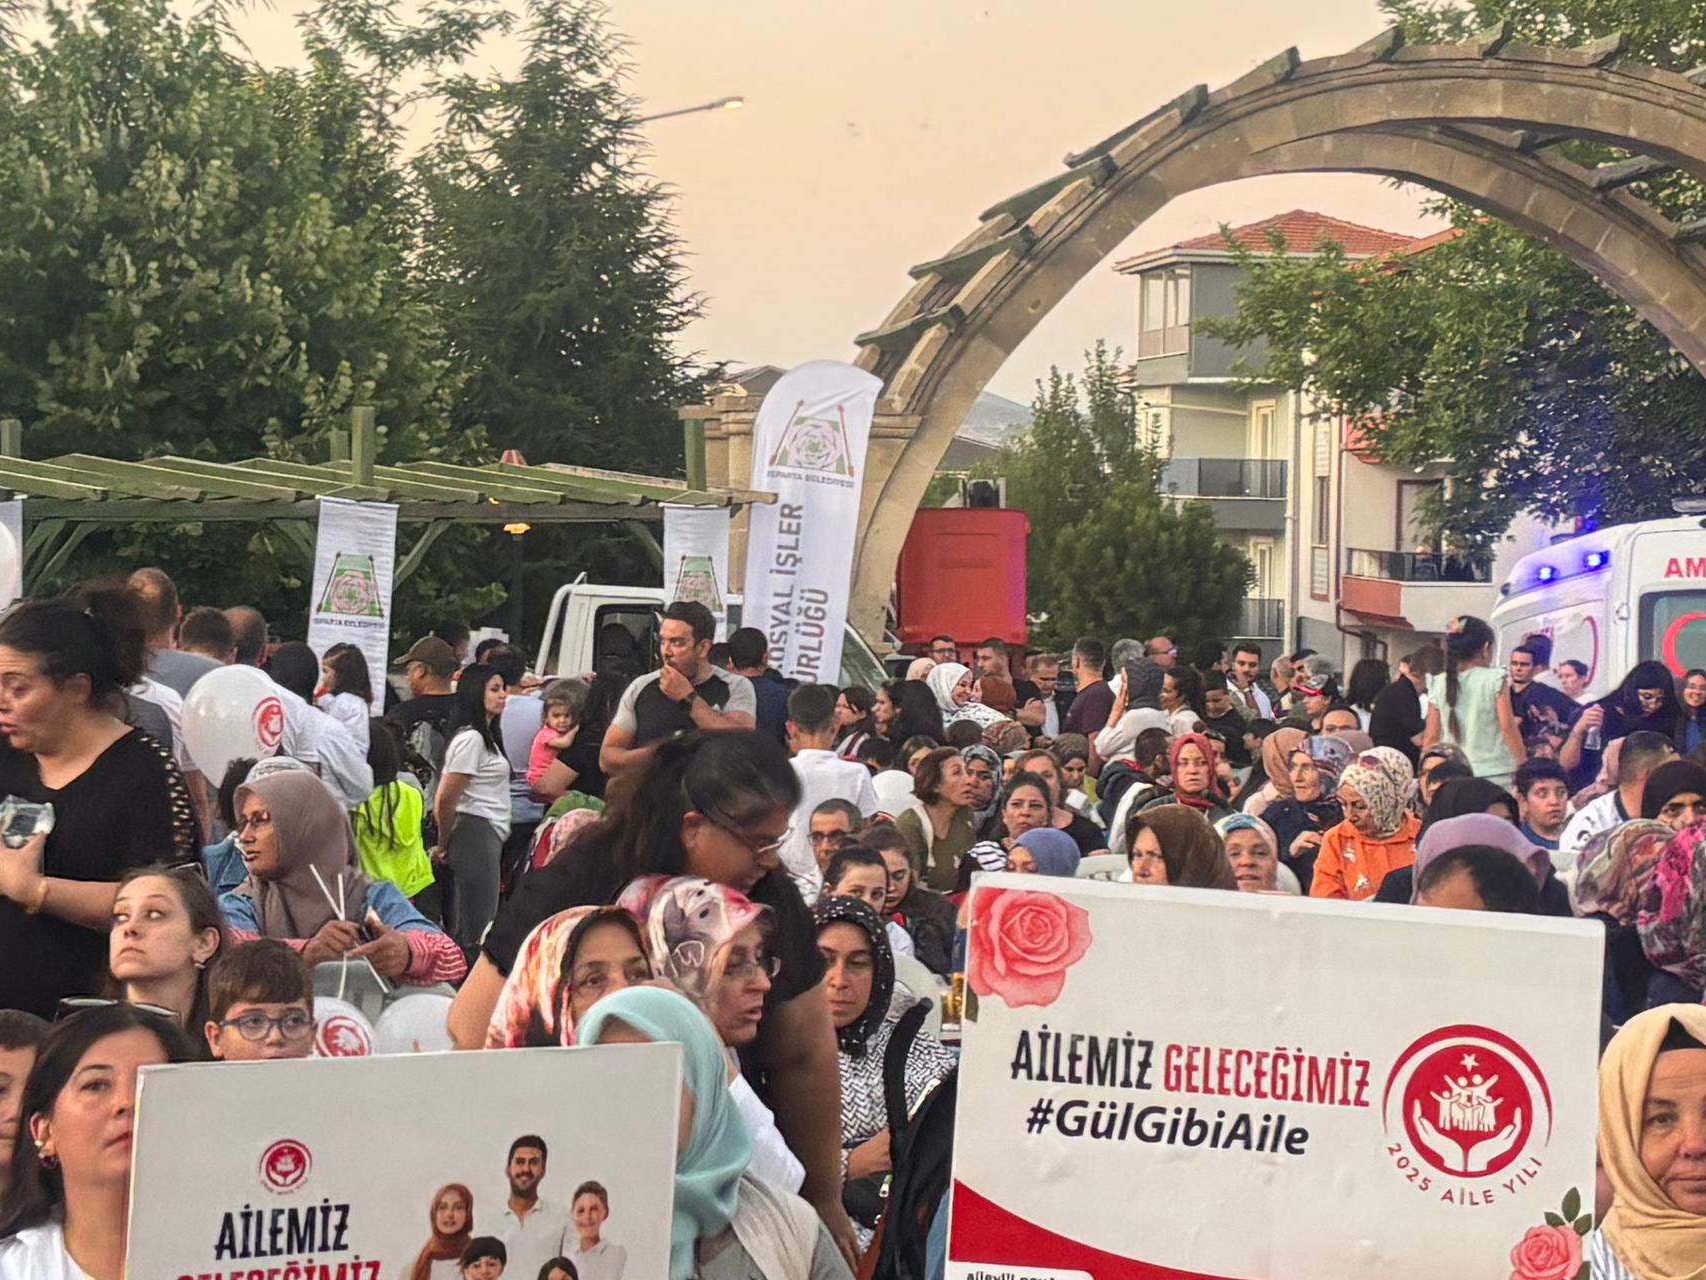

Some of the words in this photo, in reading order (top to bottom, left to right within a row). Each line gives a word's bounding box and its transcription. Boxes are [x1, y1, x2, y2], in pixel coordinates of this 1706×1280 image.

[769, 503, 804, 576] İŞLER
[768, 583, 794, 669] OSYAL
[789, 588, 829, 684] ÜRLÜĞÜ
[1011, 1023, 1154, 1091] AİLEMİZ
[1163, 1042, 1372, 1108] GELECEĞİMİZ
[1026, 1097, 1310, 1156] #GülGibiAile
[1387, 1143, 1432, 1192] 2025
[1441, 1187, 1495, 1206] AİLE
[1502, 1156, 1543, 1194] YILI
[214, 1198, 350, 1261] AİLEMİZ
